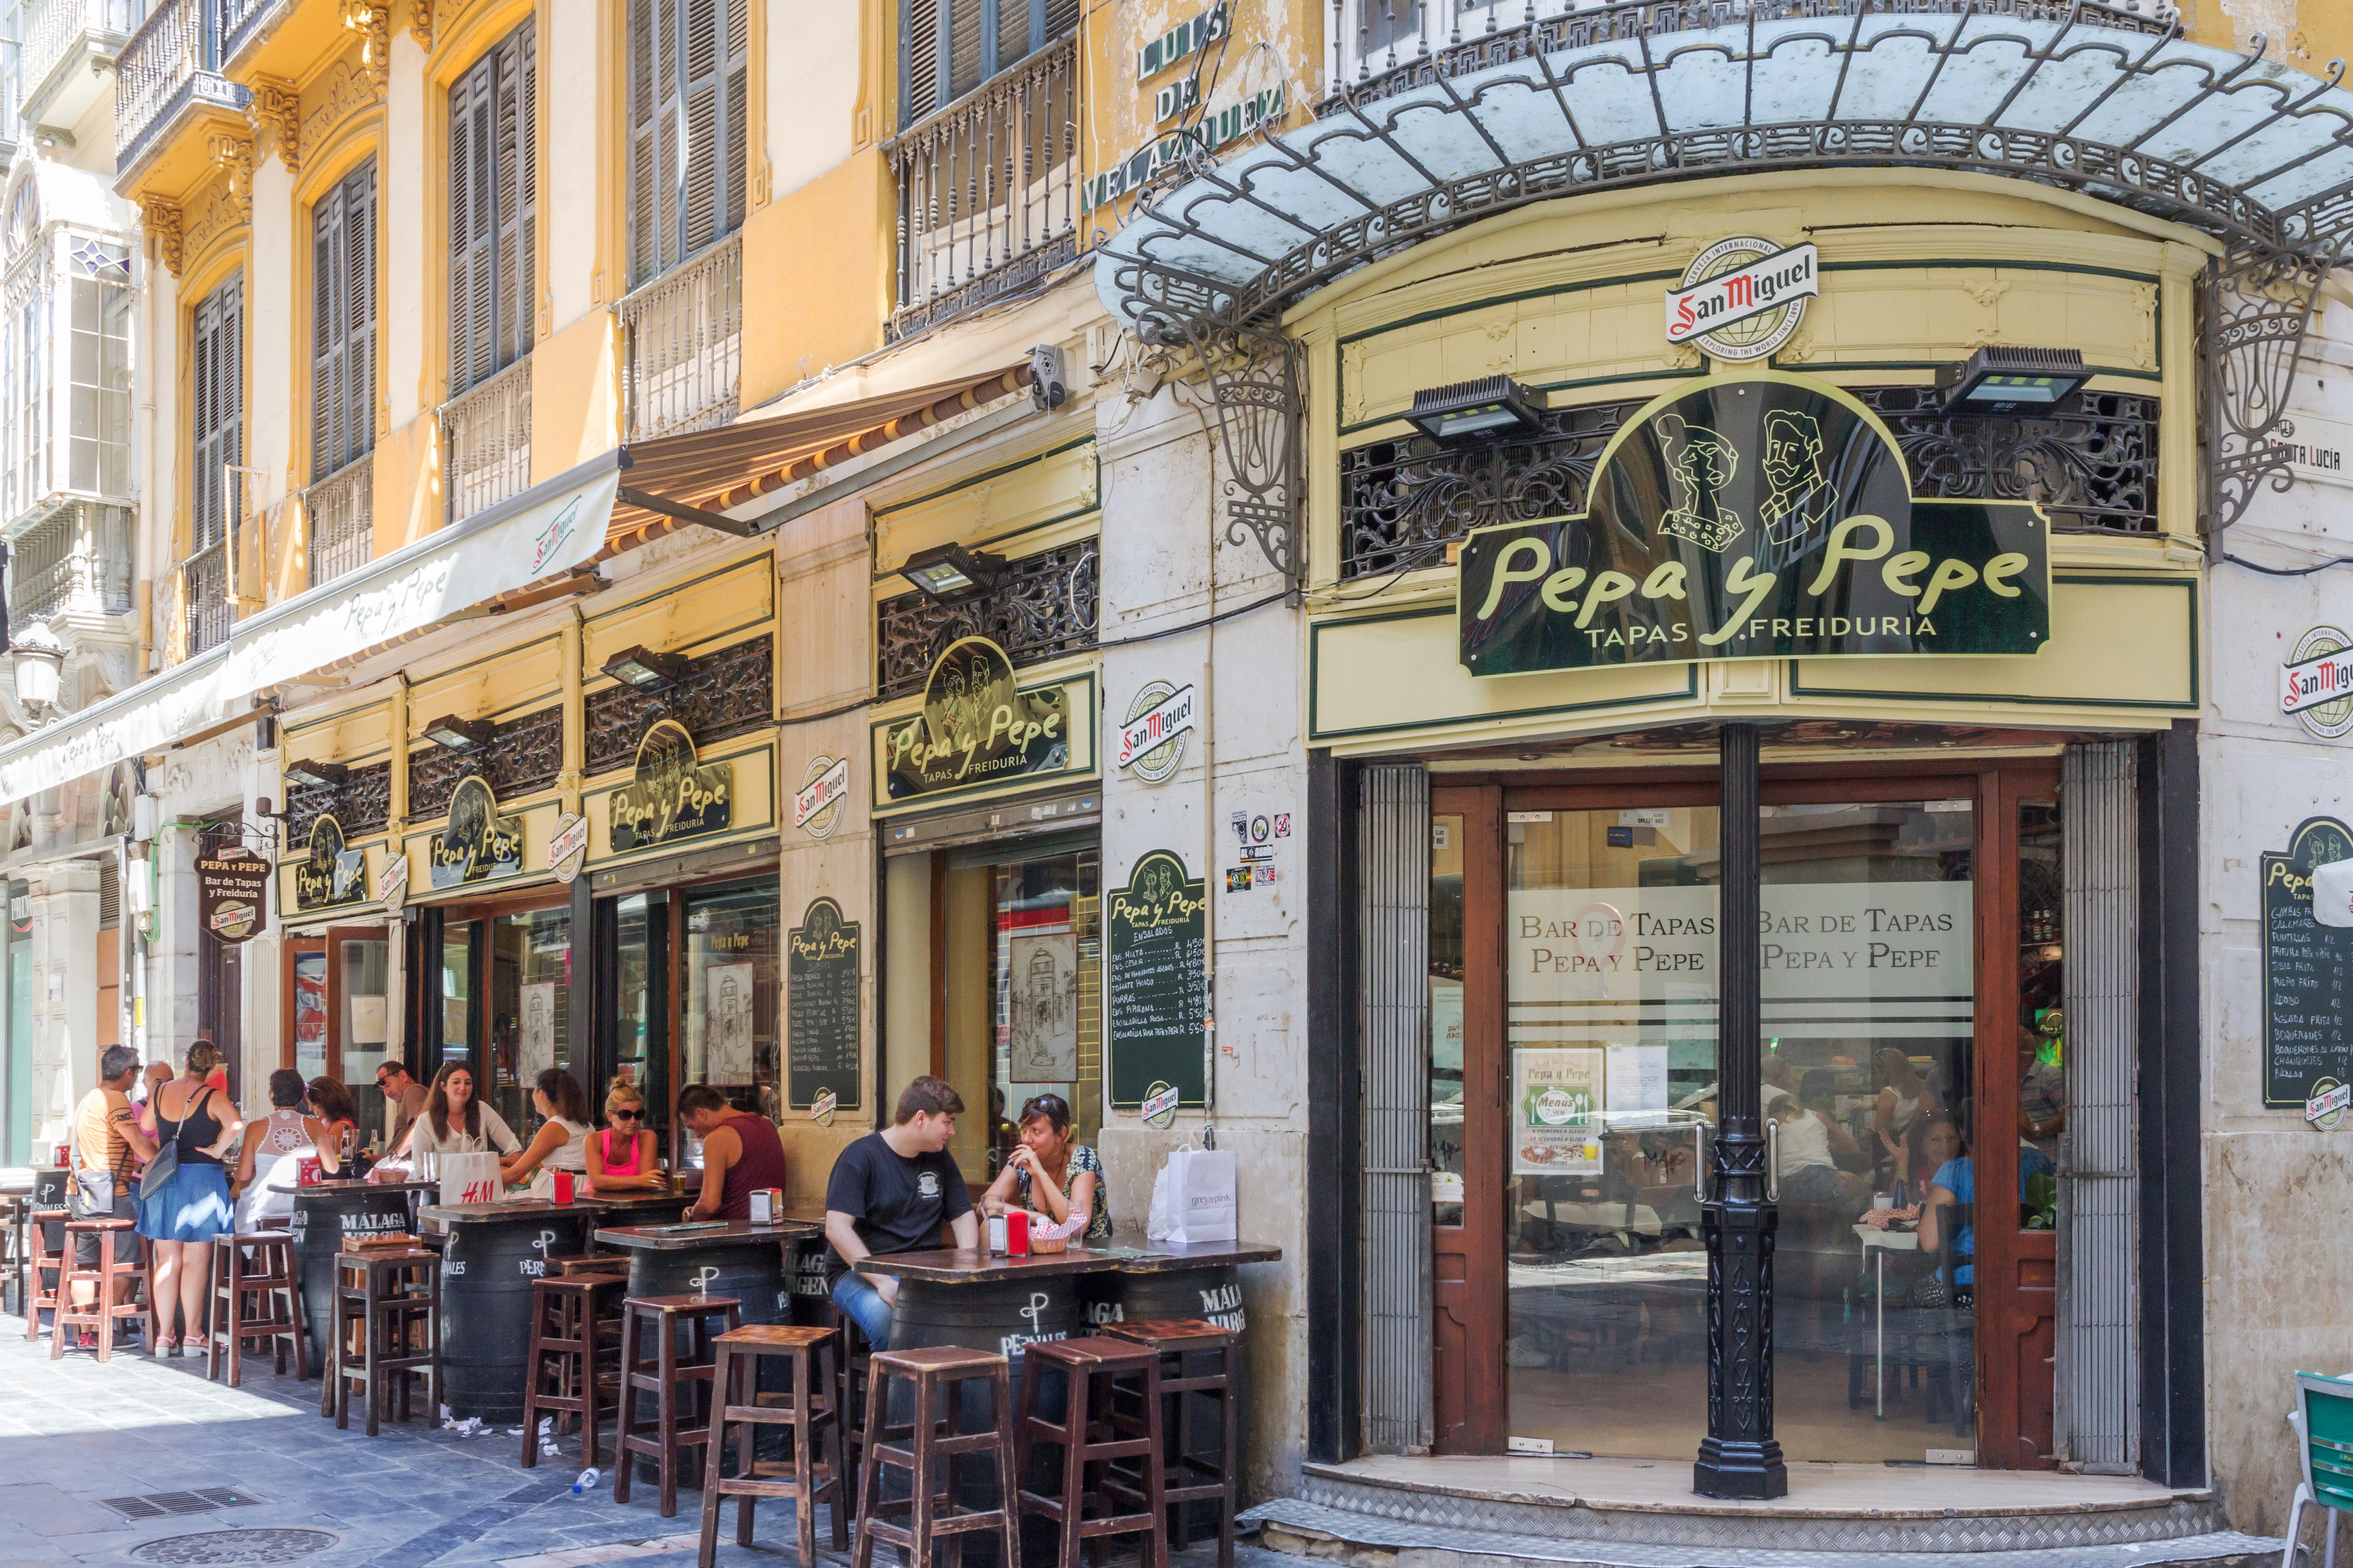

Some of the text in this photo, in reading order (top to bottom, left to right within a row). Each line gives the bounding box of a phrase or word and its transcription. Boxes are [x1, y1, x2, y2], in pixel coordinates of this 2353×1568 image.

[1138, 4, 1226, 81] LUIS
[1156, 75, 1199, 124] DE
[1688, 240, 1773, 284] CERVEZA INTERNACIONAL
[1701, 302, 1799, 356] EXPLORING THE WORLD SINCE 1890
[2270, 438, 2340, 470] STA LUCÍA
[1477, 514, 2029, 646] Pepa y Pepe
[1584, 615, 1937, 648] TAPAS FREIDURIA
[2296, 629, 2348, 661] CERVEZA INTERNACIONAL
[1129, 685, 1172, 720] CERVEZA INTERNACIONAL
[891, 704, 1060, 780] Pepa y Pepe
[2326, 727, 2334, 735] THE
[2335, 722, 2350, 735] WORLD
[923, 754, 1028, 785] TAPAS FREIDURIA
[1134, 762, 1153, 778] EXPLORING
[1160, 763, 1174, 776] WORLD
[613, 777, 726, 838] Pepa y Pepe
[634, 817, 705, 840] TAPAS FREIDURIA
[433, 825, 520, 878] Pepa y Pepe
[200, 860, 229, 871] PEPA
[238, 863, 266, 872] PEPE
[448, 862, 503, 878] TAPAS FREIDURIA
[2267, 862, 2314, 894] Pepa
[205, 876, 262, 888] Bar de Tapas
[209, 888, 258, 898] y Freiduría
[298, 858, 364, 903] Pepa y Pepe
[1112, 890, 1205, 928] Pepa y Pepe
[1157, 917, 1190, 926] FREIDURIA
[1819, 915, 1856, 933] DE
[1863, 907, 1953, 933] TAPAS
[1133, 925, 1173, 943] ENSALADAS
[1519, 912, 1715, 939] BAR DE TAPAS
[791, 931, 857, 961] Pepa y Pepe
[1761, 943, 1942, 970] PEPA Y PEPE
[1530, 946, 1705, 974] PEPA Y PEPE
[1112, 981, 1134, 994] TOMATE
[1112, 993, 1136, 1006] PORRAS
[1527, 1068, 1591, 1080] Pepa y Pepe
[1537, 1096, 1575, 1107] Menús
[461, 1179, 495, 1204] H&M
[1191, 1193, 1232, 1207] grey&pink
